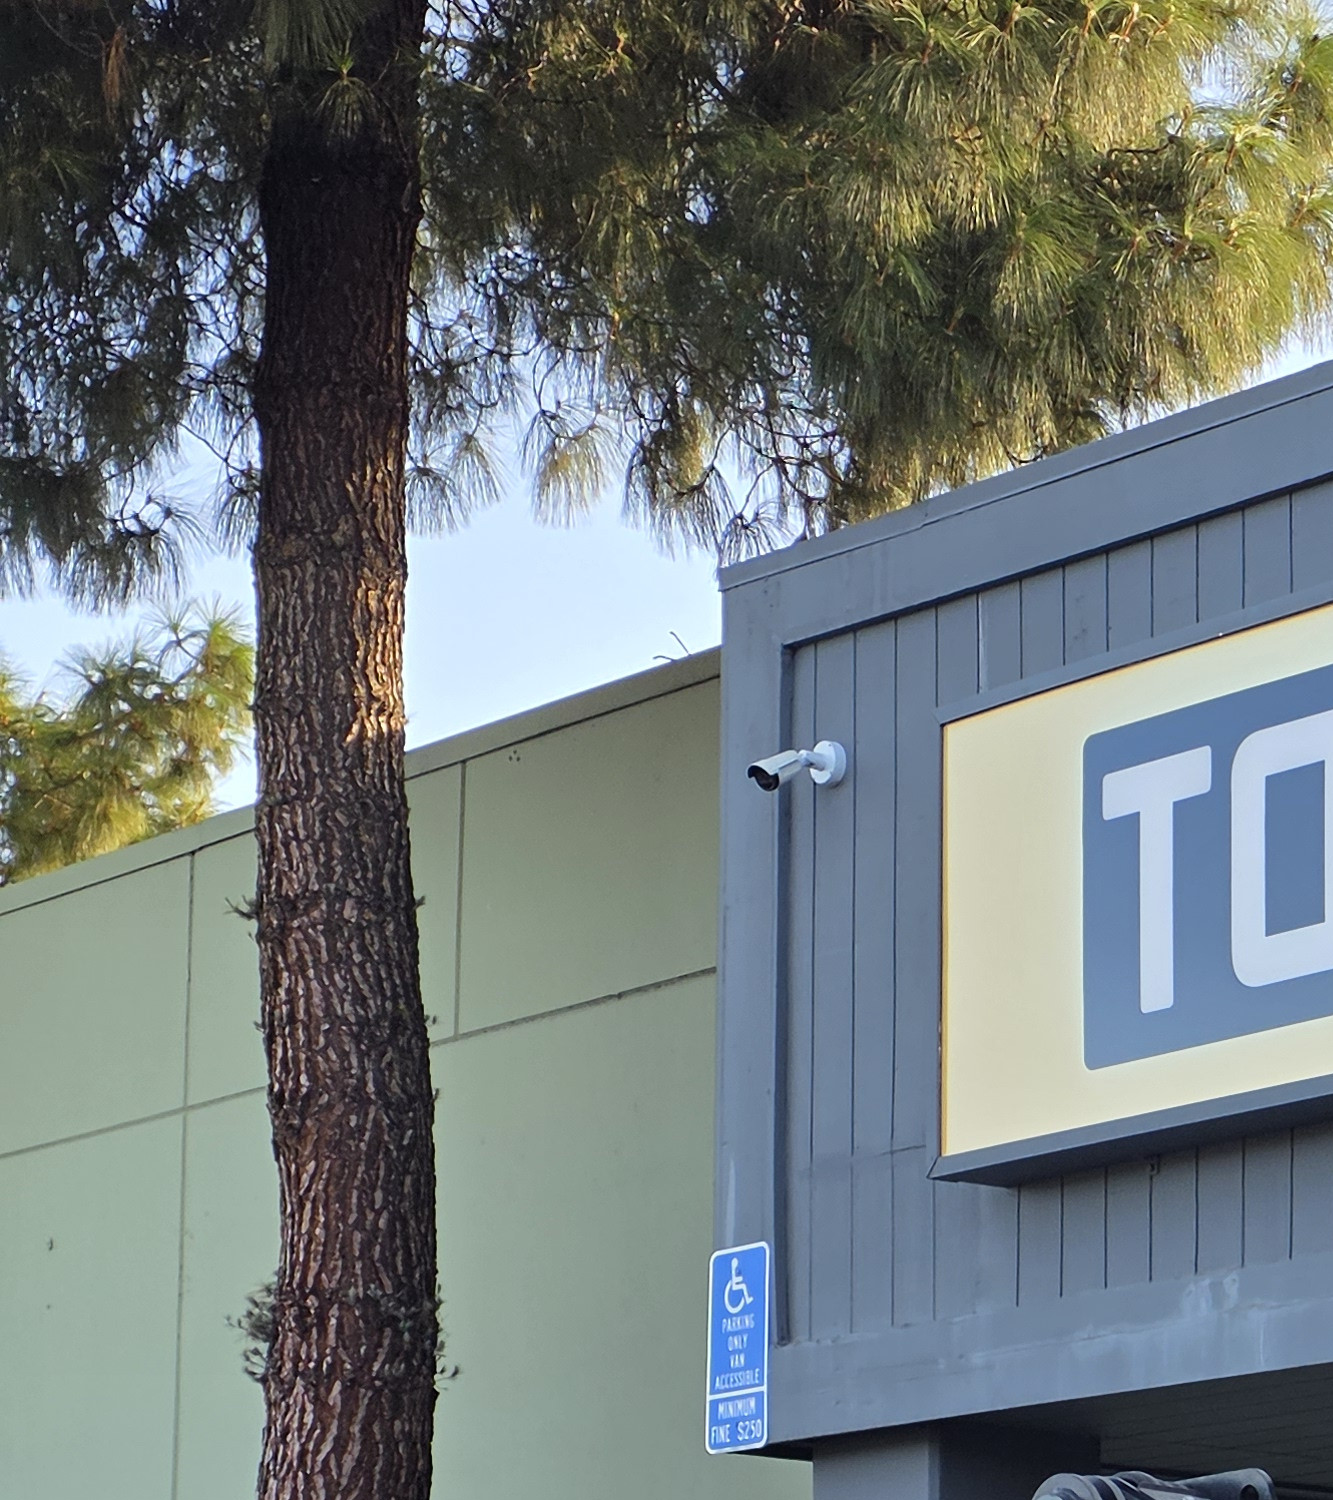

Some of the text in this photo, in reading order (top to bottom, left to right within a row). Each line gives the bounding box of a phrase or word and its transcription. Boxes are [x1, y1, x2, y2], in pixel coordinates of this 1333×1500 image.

[722, 1313, 755, 1334] PARKING
[728, 1334, 749, 1351] ONLY
[730, 1353, 745, 1369] VAN
[714, 1368, 760, 1391] ACCESSIBLE
[718, 1397, 756, 1420] MINIMUM
[711, 1419, 762, 1445] FINE $250
